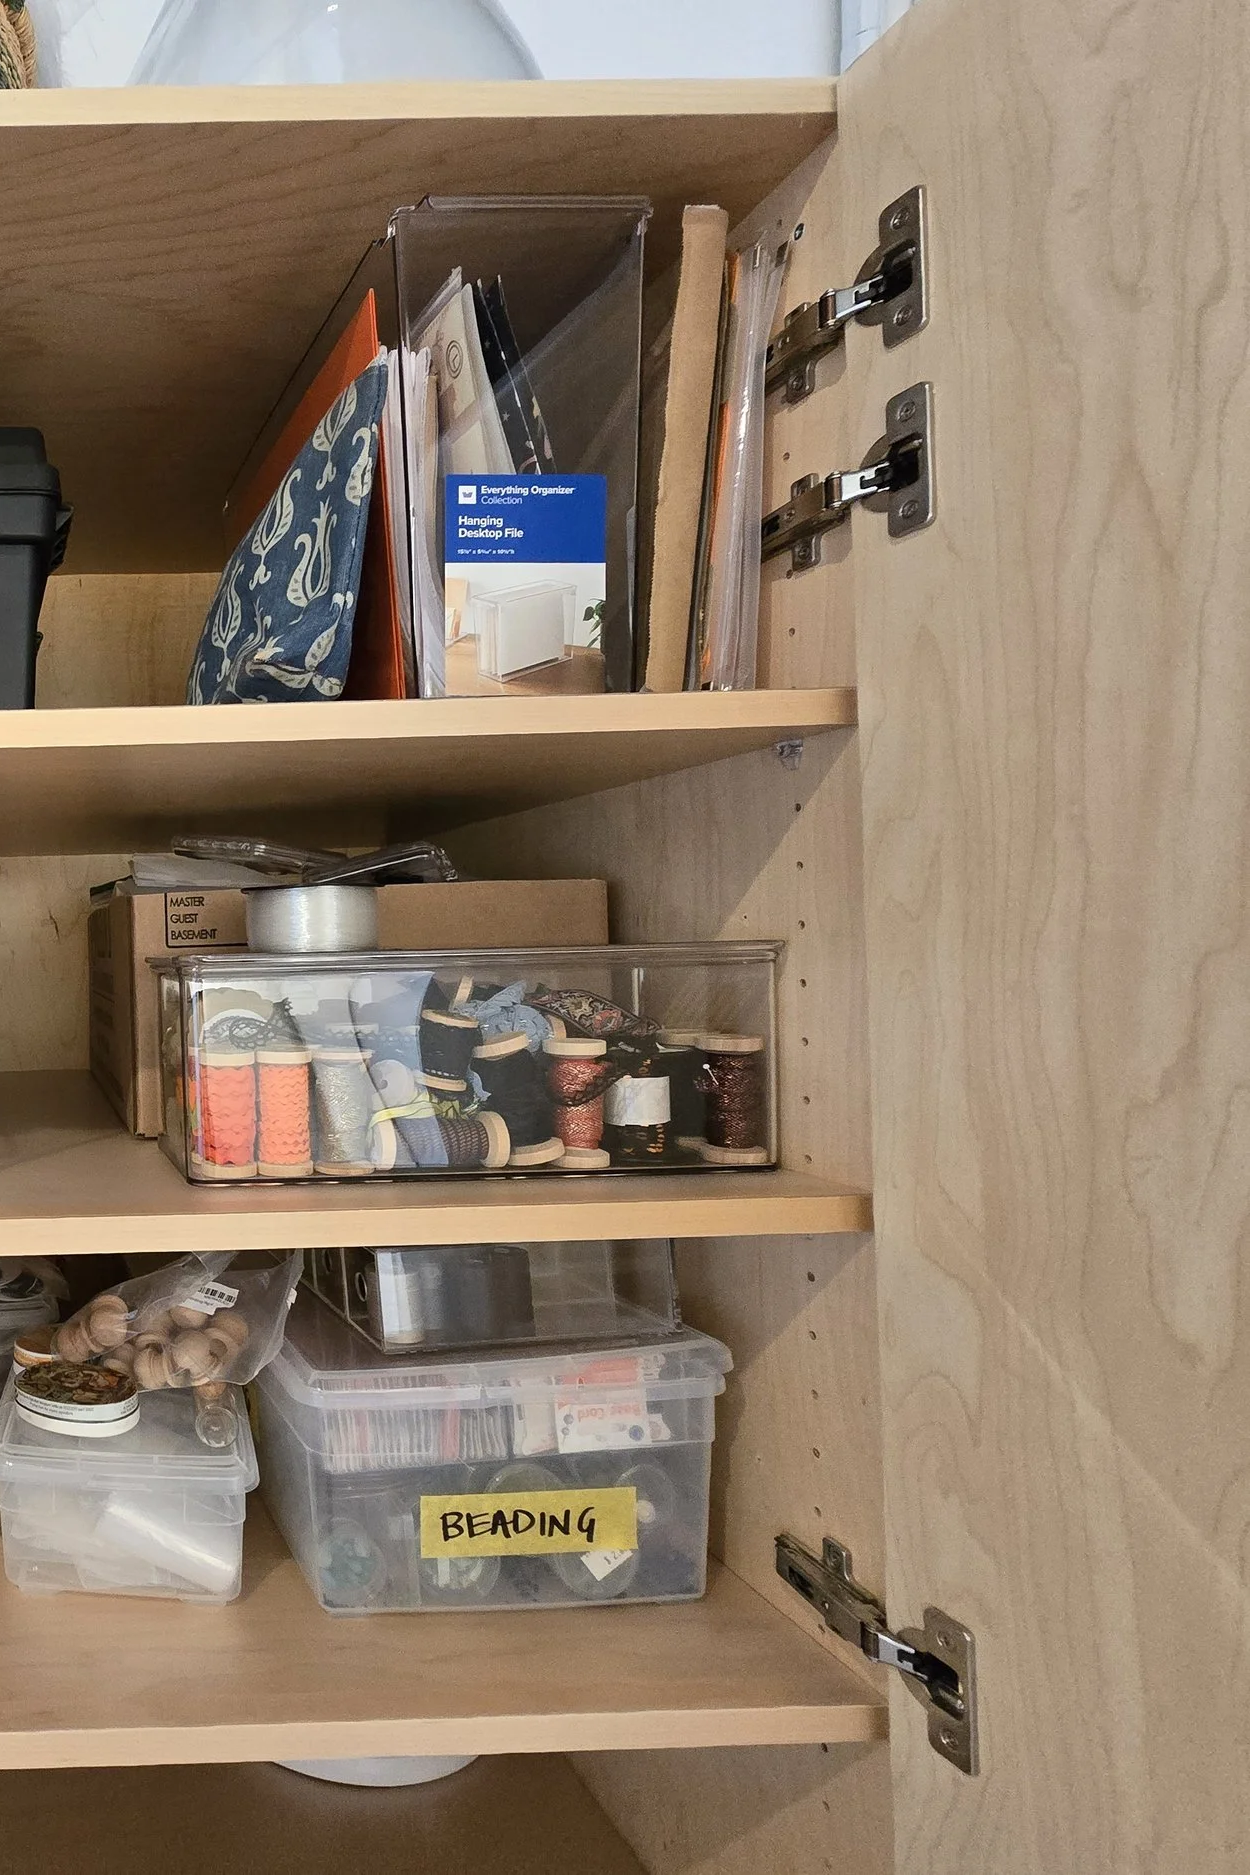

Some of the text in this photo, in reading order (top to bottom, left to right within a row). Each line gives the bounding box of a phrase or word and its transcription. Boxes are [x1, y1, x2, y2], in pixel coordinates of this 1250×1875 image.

[480, 485, 575, 496] Everything Organizer
[480, 496, 523, 505] Collection
[458, 515, 503, 528] Hanging
[458, 528, 524, 540] Desktop File
[170, 896, 205, 907] MASTER
[170, 913, 198, 924] GUEST
[170, 929, 218, 940] BASEMENT
[440, 1506, 596, 1543] BEADING
